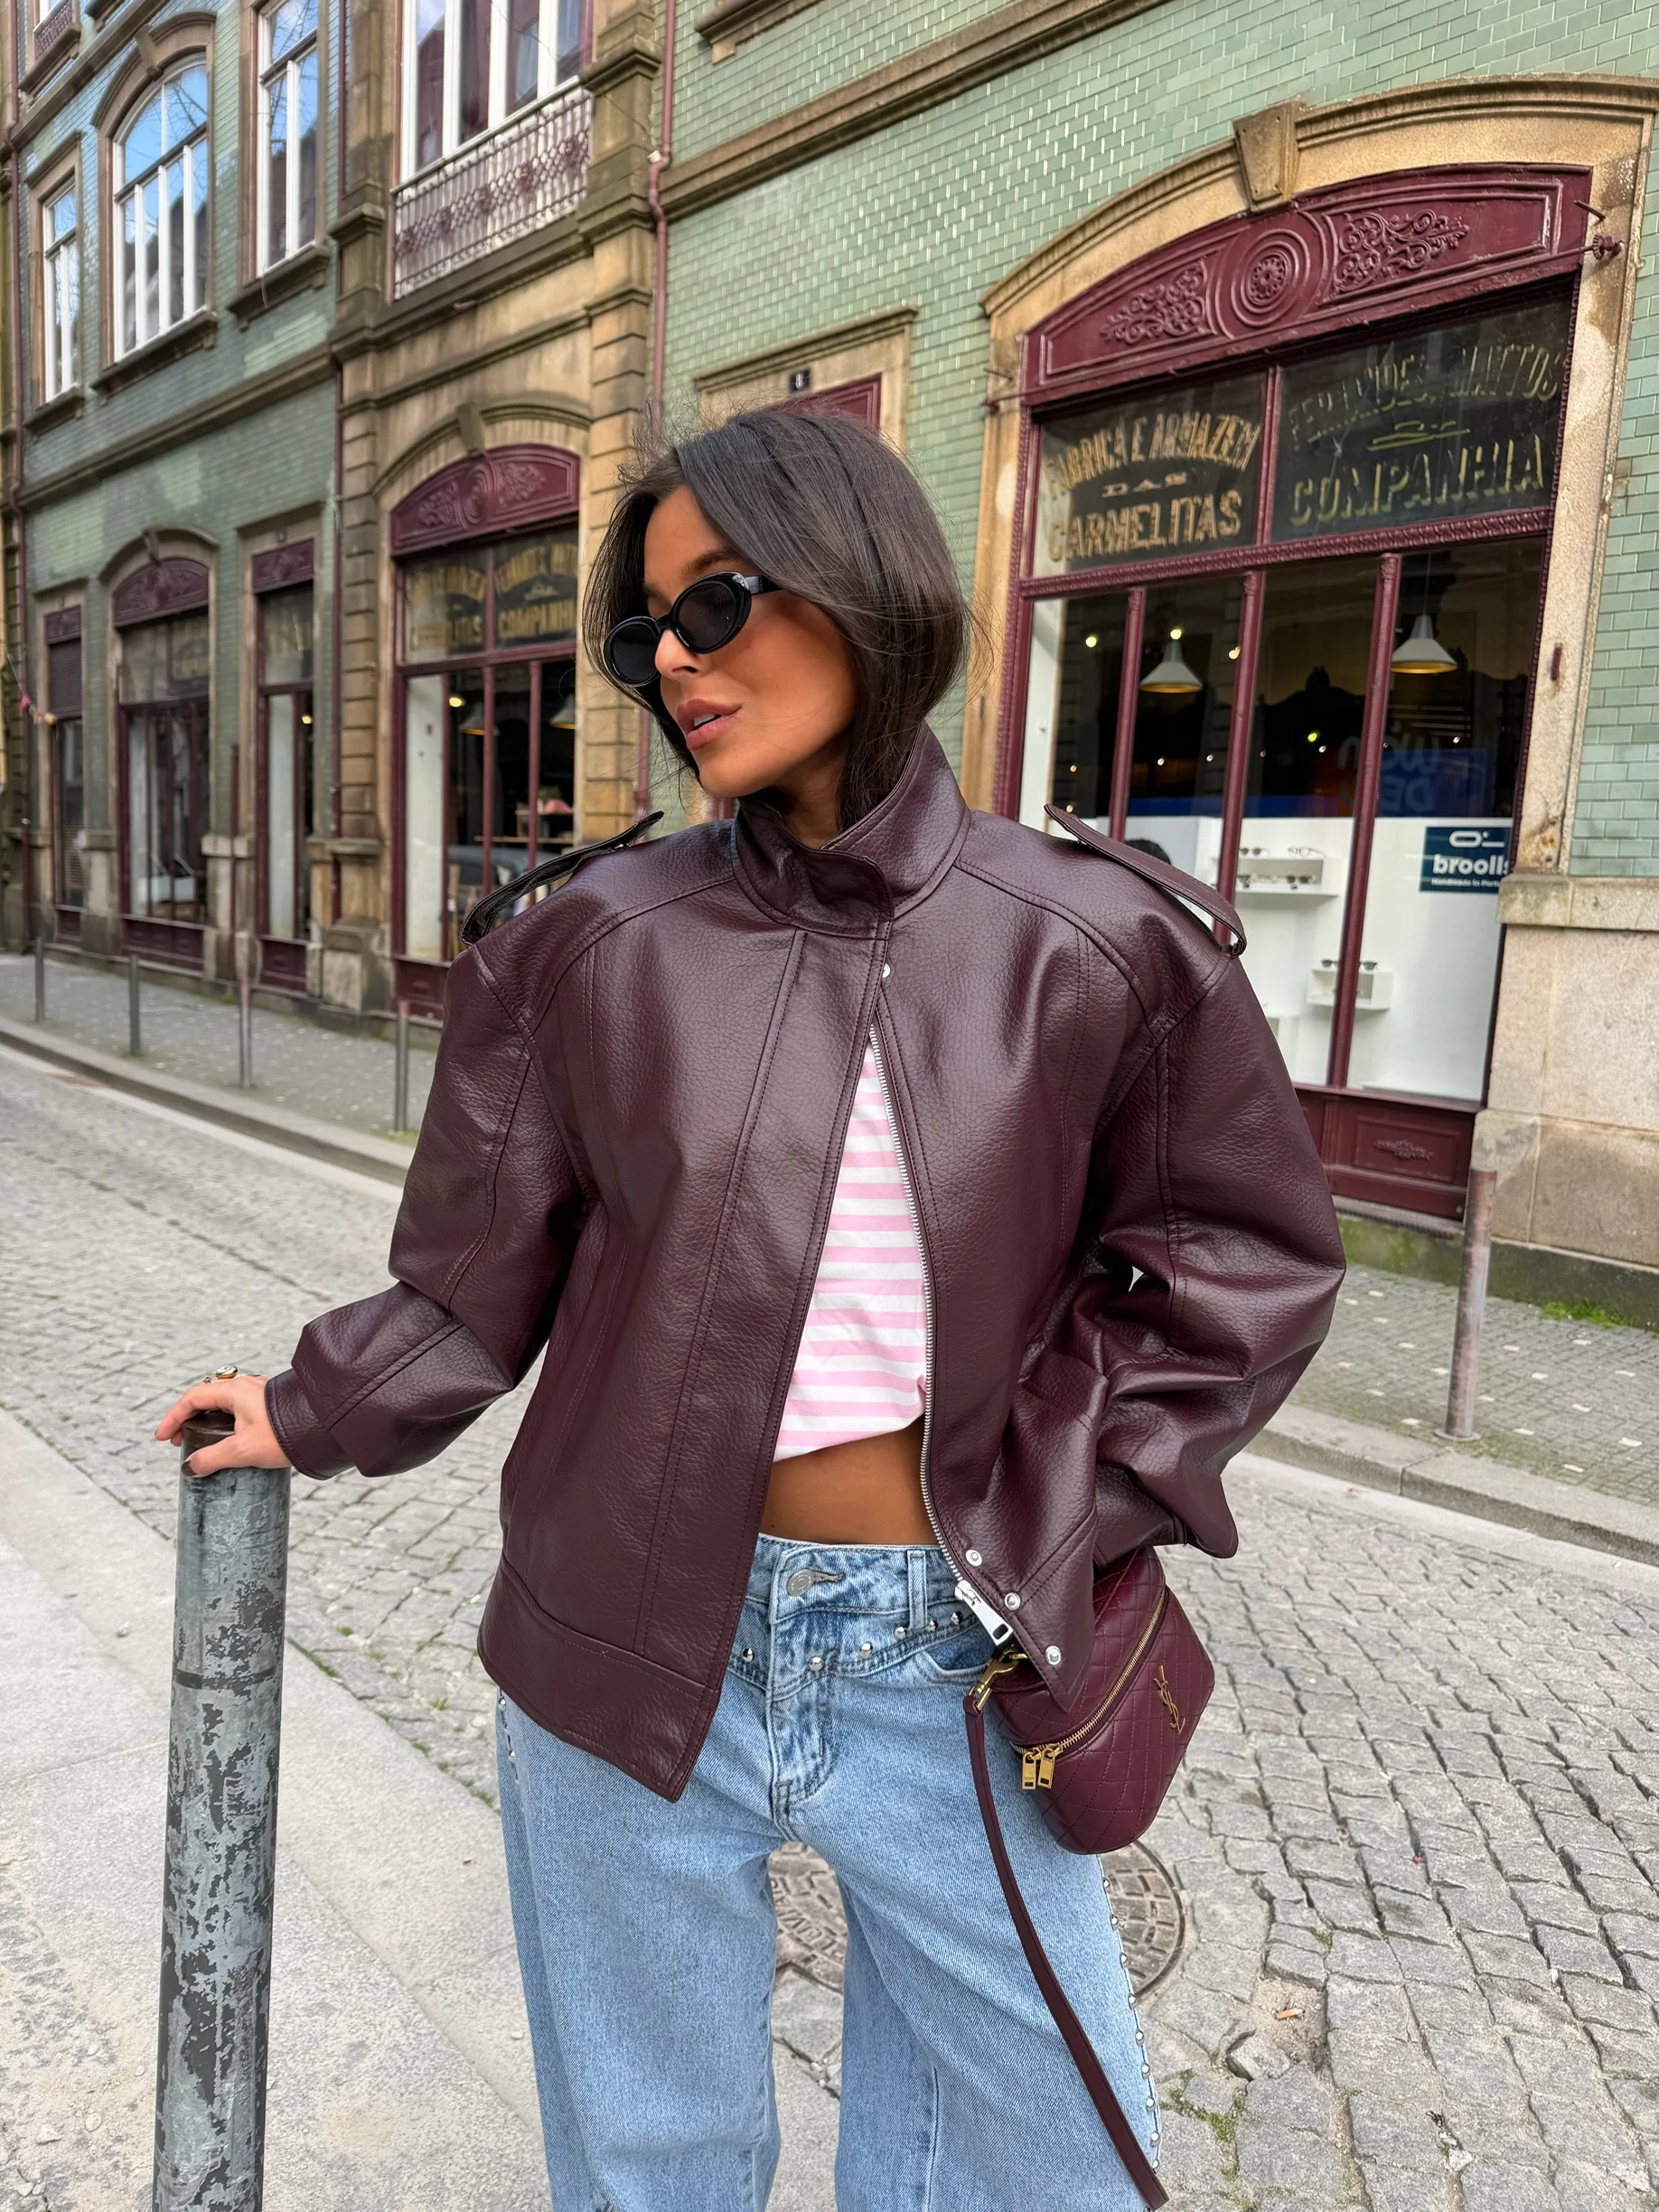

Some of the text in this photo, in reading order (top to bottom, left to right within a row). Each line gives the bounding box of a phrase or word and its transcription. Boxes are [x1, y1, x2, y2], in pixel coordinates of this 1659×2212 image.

[1131, 416, 1148, 462] E
[1148, 412, 1261, 471] ARMAZEM
[1101, 471, 1187, 498] DAS
[1048, 489, 1242, 563] CARMELITAS
[1431, 877, 1471, 886] Handmade
[1472, 878, 1480, 886] in
